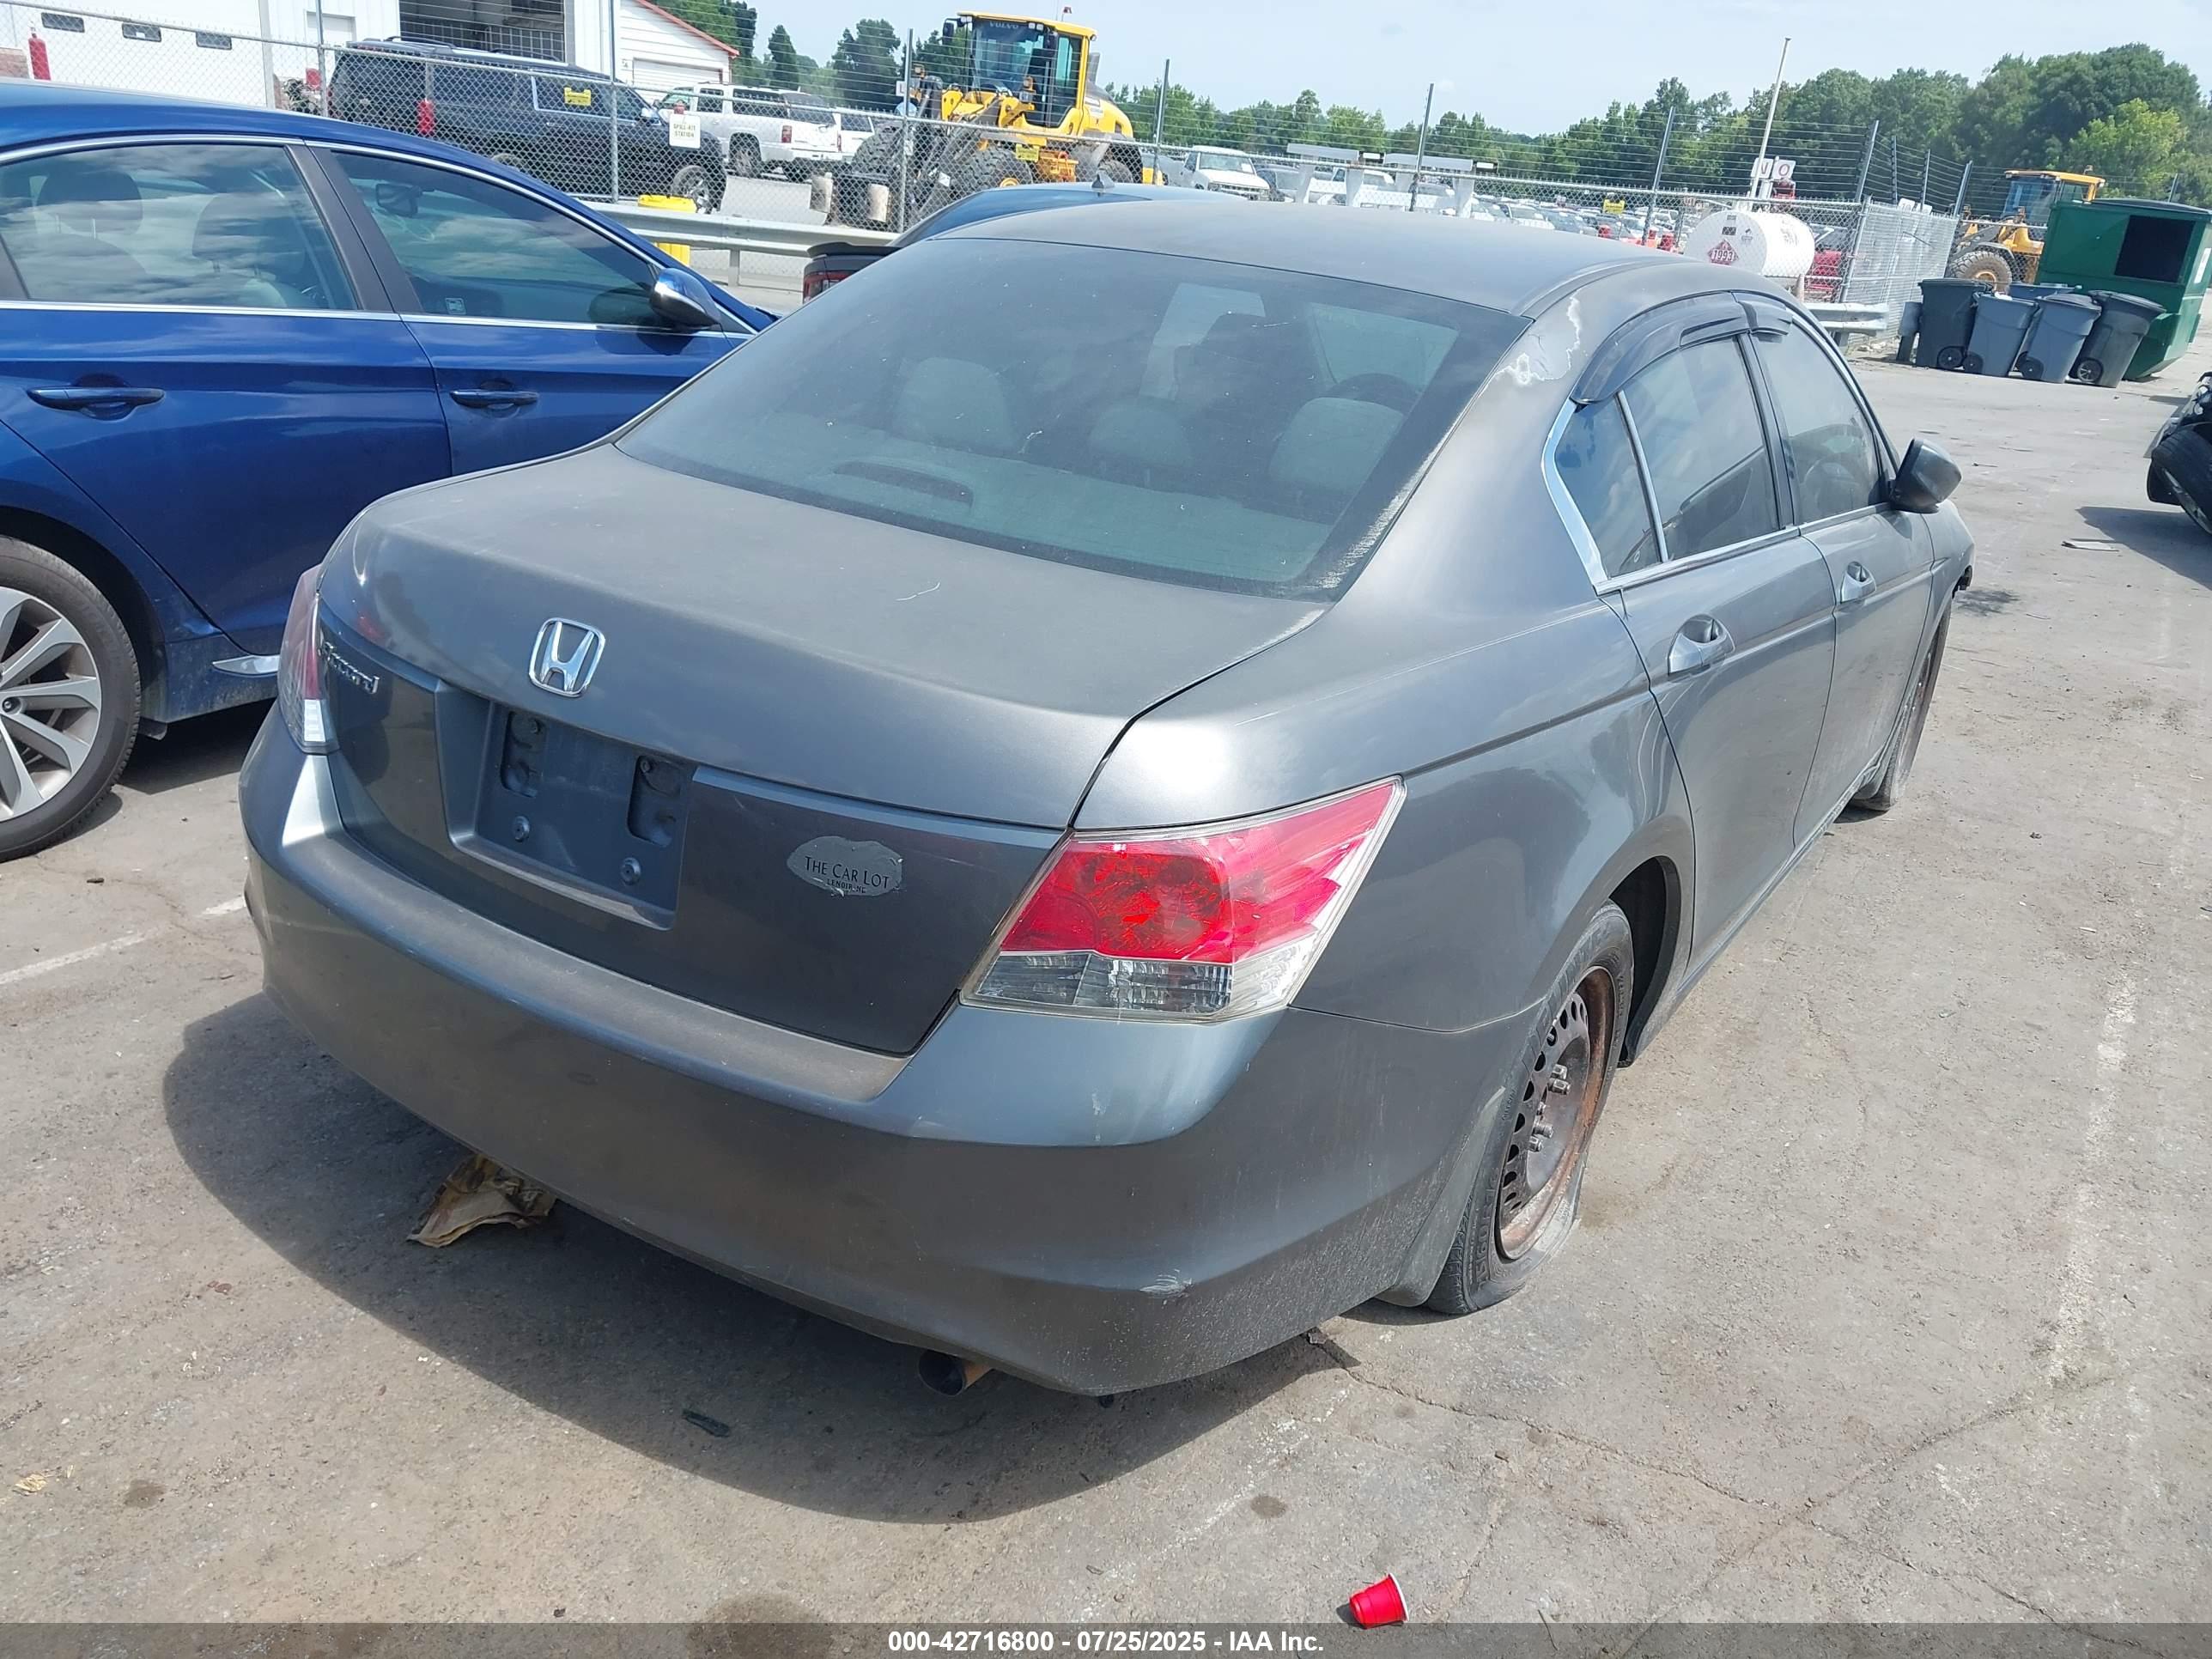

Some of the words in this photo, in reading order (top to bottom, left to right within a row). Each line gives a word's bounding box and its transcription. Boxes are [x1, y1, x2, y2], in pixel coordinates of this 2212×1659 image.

[989, 20, 1018, 29] VOLVO
[1713, 249, 1733, 261] 1993
[805, 855, 828, 876] THE
[832, 864, 859, 883] CAR
[863, 870, 890, 889] LOT
